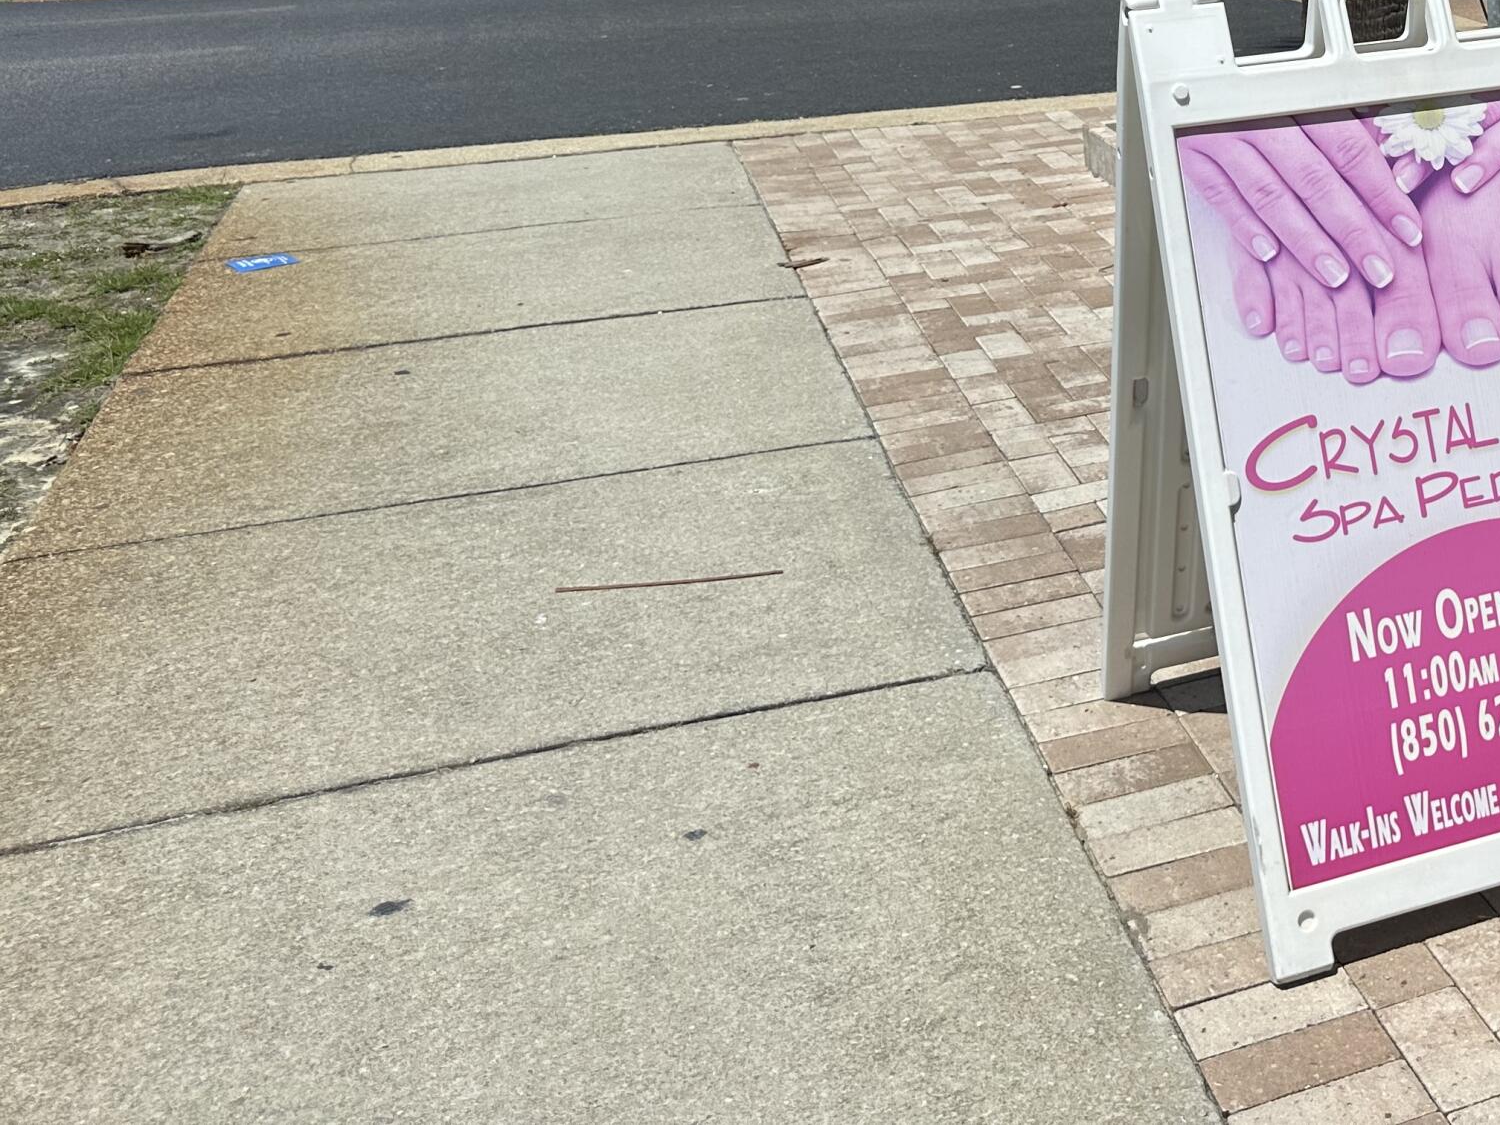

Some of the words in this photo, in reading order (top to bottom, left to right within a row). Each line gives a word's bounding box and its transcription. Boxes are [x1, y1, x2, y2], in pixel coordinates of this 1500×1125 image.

[1244, 401, 1500, 492] CRYSTAL
[1292, 496, 1405, 543] SPA
[1345, 607, 1423, 663] NOW
[1384, 650, 1500, 709] 11:00AM
[1389, 705, 1469, 776] (850)
[1300, 805, 1401, 867] WALK-INS
